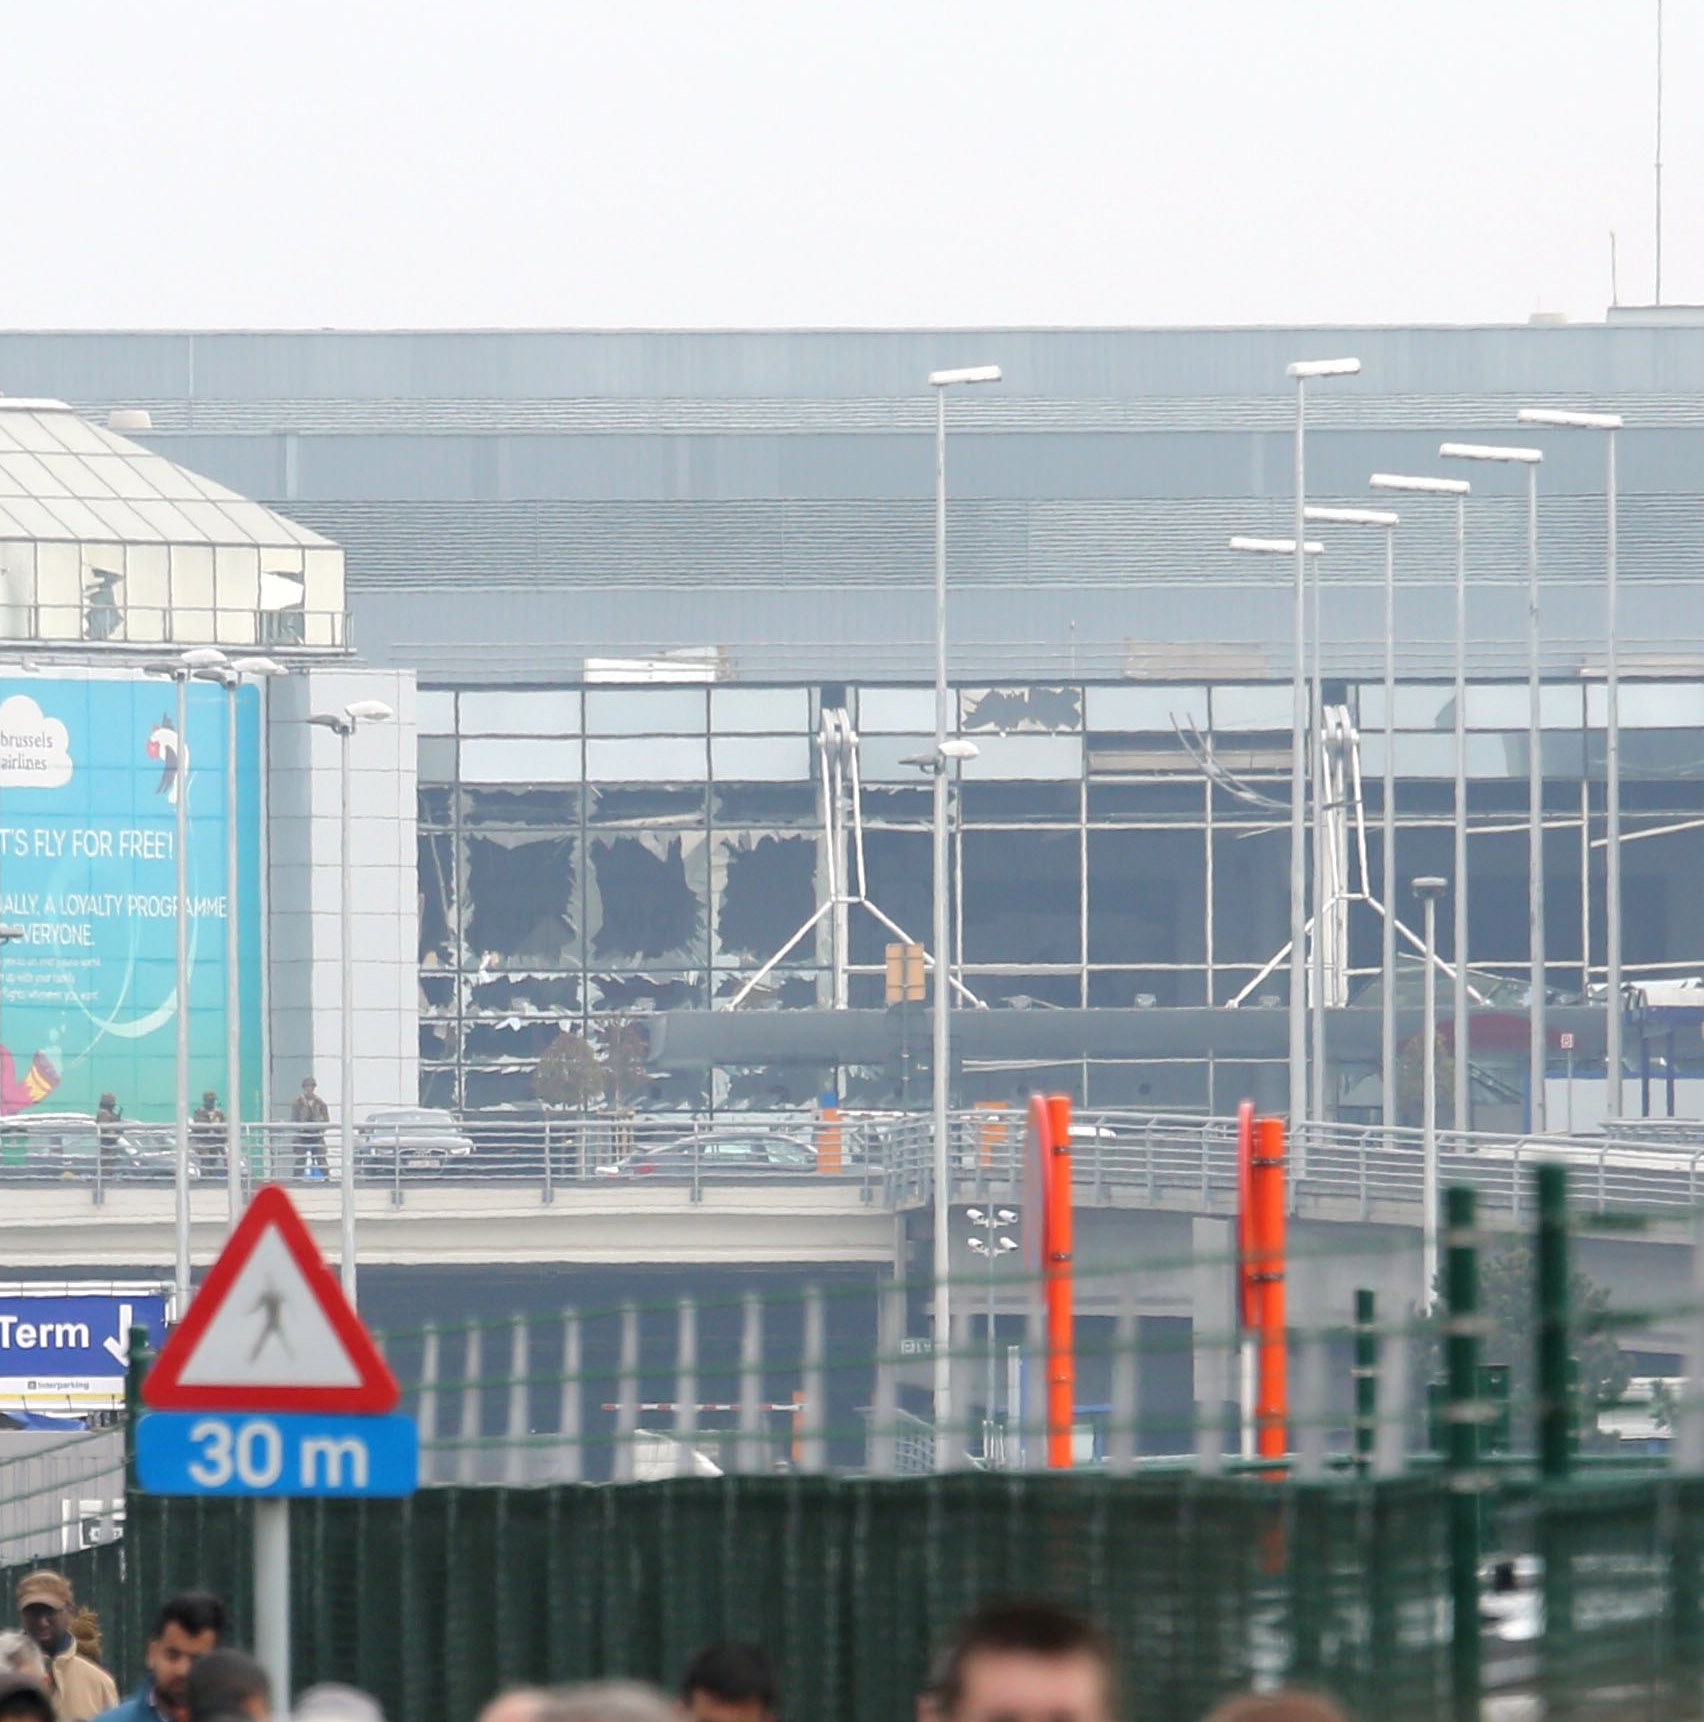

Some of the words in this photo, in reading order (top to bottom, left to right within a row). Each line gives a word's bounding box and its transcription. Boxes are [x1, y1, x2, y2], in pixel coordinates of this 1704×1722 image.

[0, 730, 53, 748] brussels
[1, 753, 47, 770] airlines
[35, 829, 66, 857] FLY
[72, 829, 112, 858] FOR
[119, 830, 173, 859] FREE!
[44, 894, 56, 916] A
[61, 893, 123, 917] LOYALTY
[189, 1419, 282, 1488] 30
[300, 1437, 368, 1488] m
